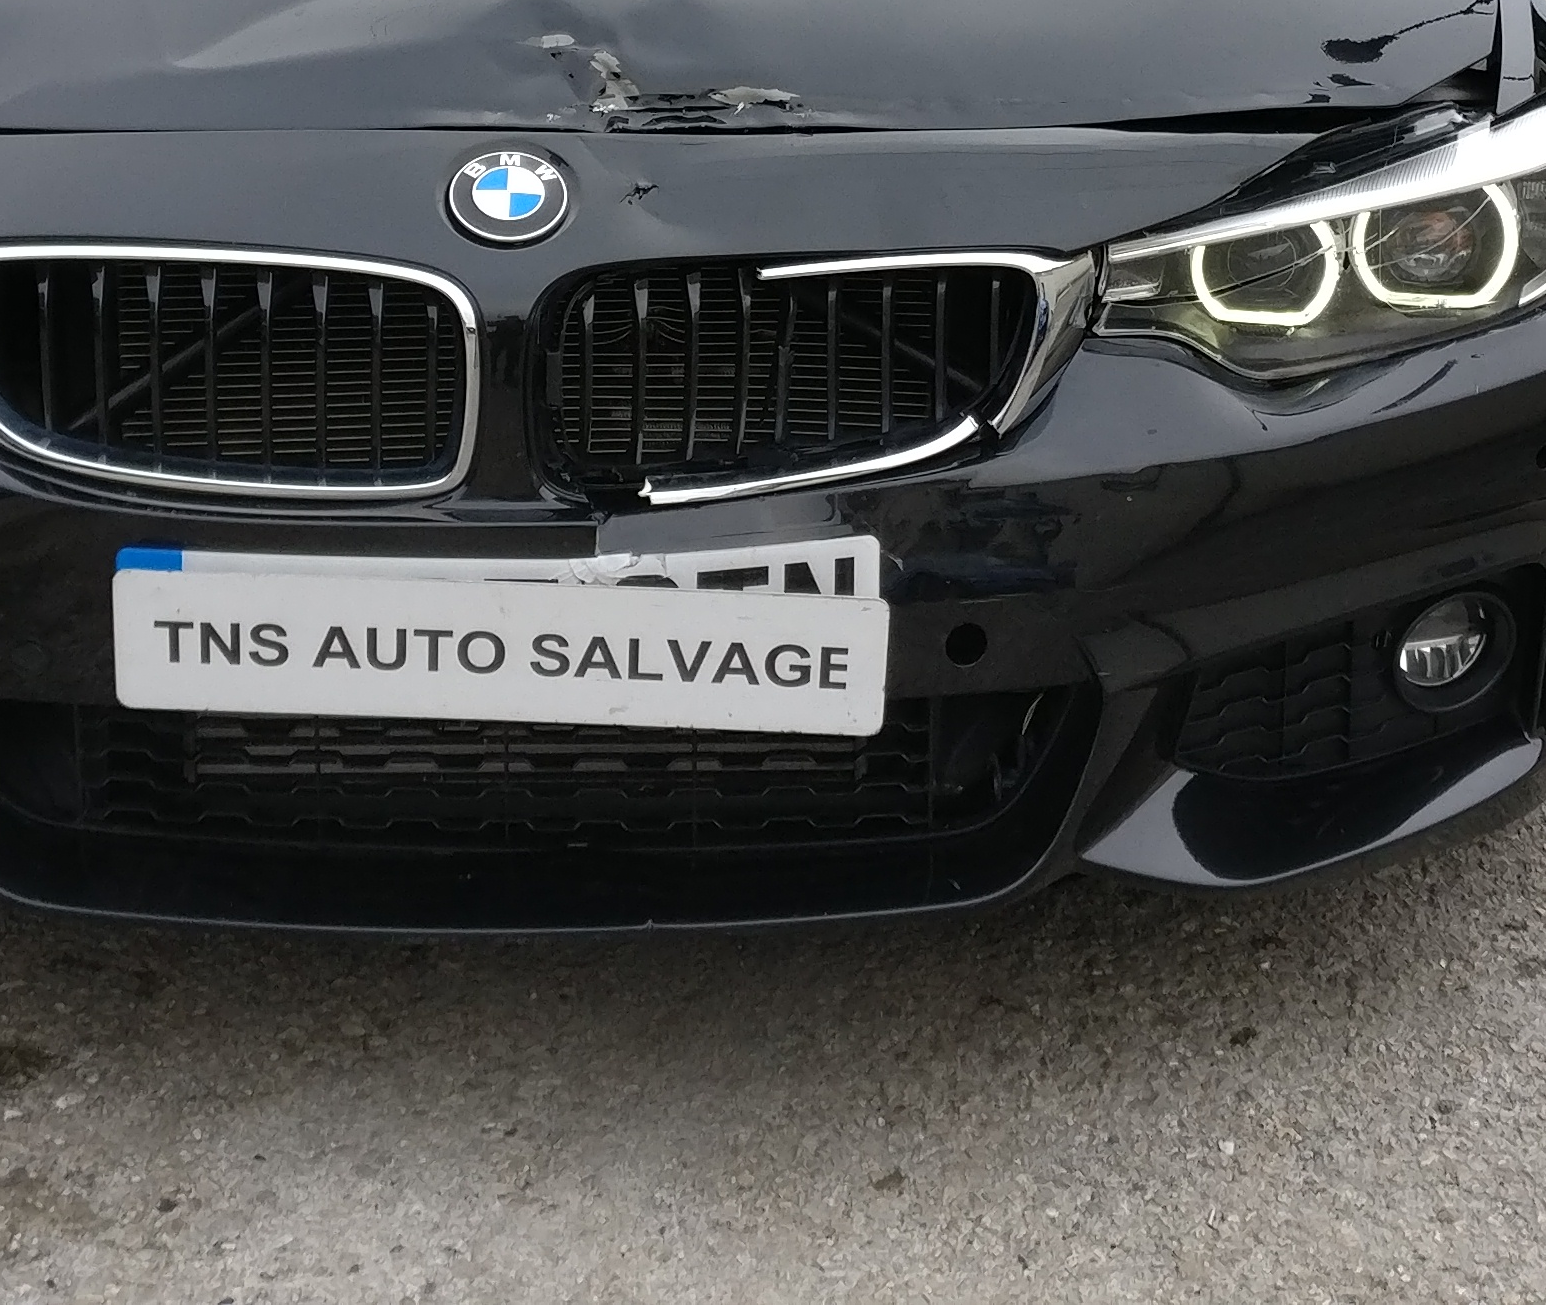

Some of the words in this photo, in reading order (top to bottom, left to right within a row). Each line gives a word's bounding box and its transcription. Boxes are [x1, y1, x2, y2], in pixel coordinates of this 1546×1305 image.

[463, 154, 557, 181] BMW
[153, 620, 289, 667] TNS
[313, 625, 506, 674] AUTO
[530, 633, 850, 691] SALVAGE
